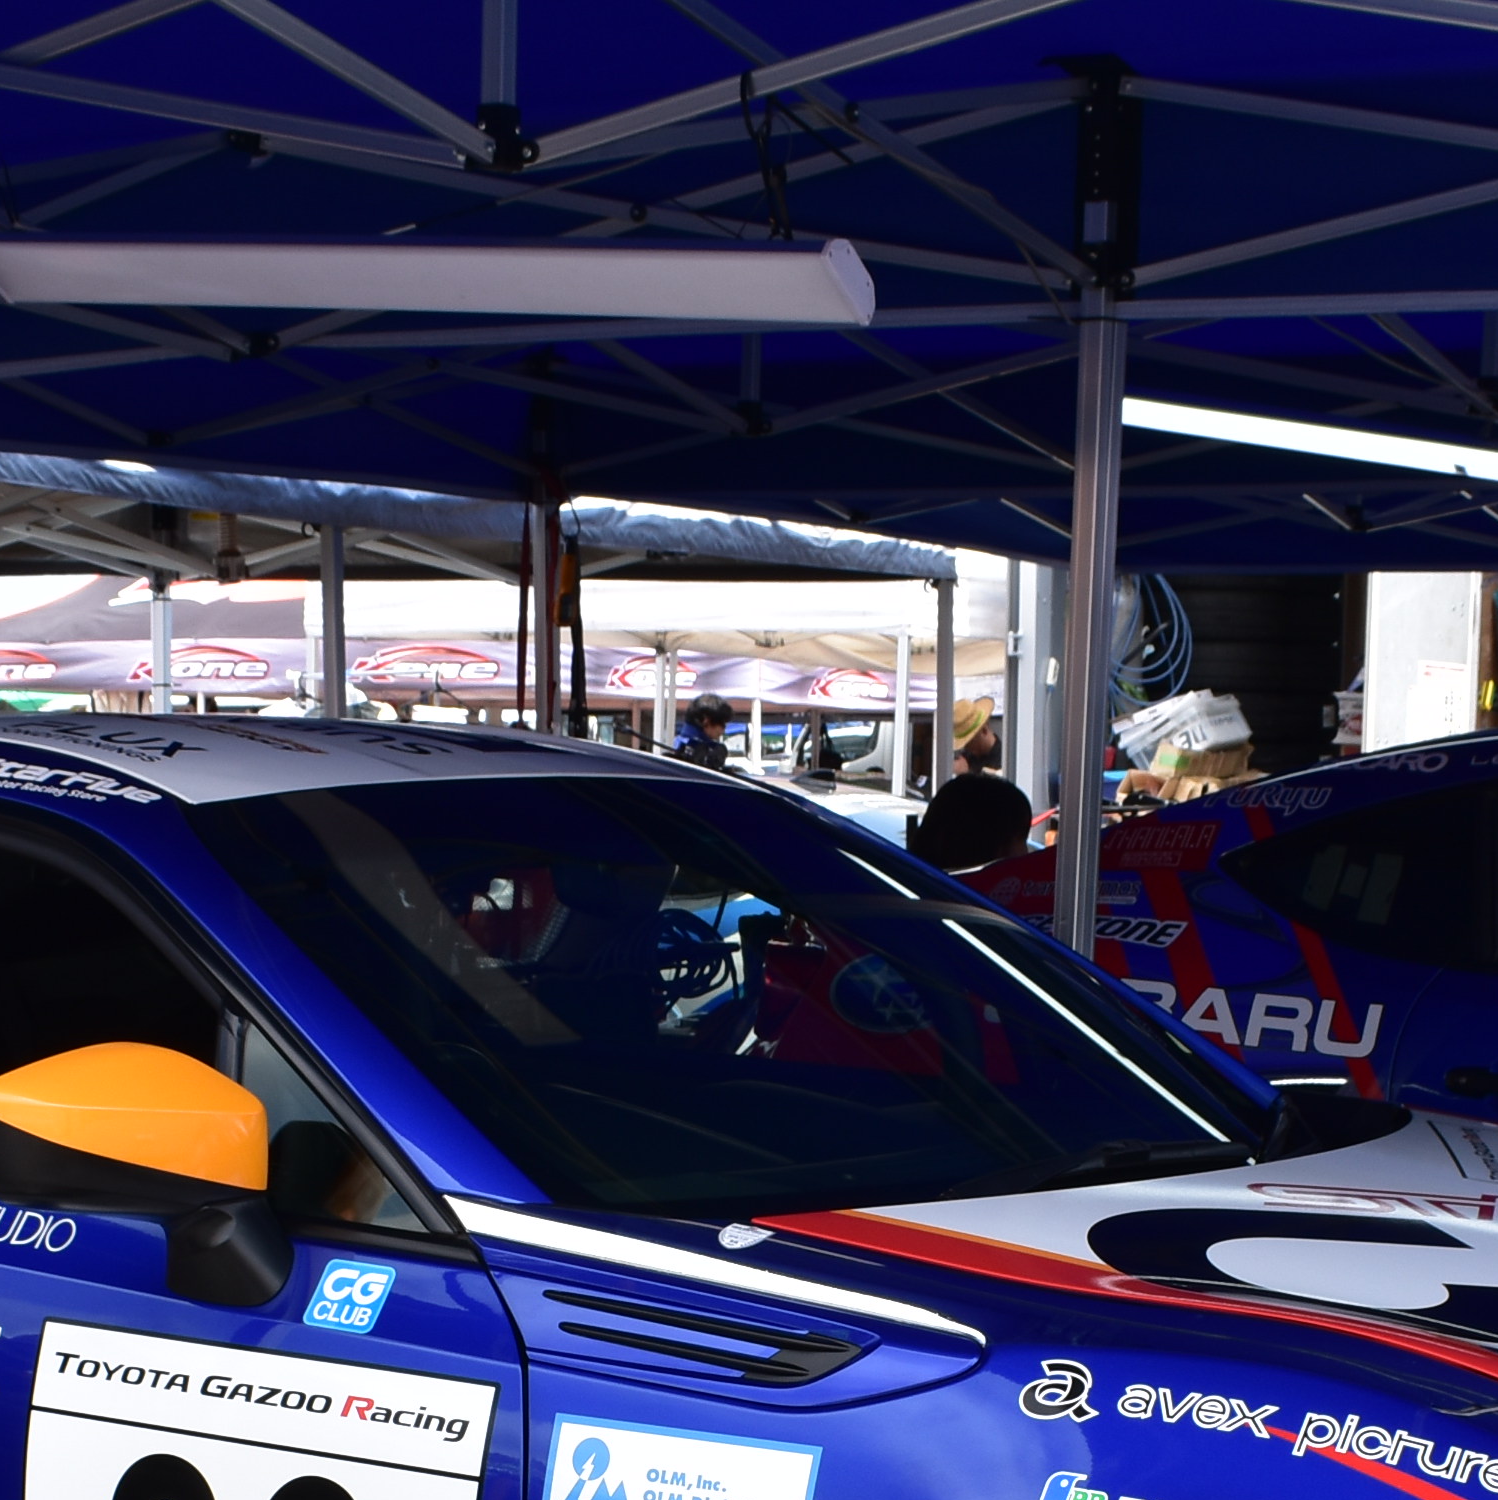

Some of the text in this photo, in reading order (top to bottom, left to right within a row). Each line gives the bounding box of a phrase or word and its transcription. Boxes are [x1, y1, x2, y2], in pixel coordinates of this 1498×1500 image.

[319, 1267, 387, 1306] CG
[310, 1299, 374, 1328] CLUB
[55, 1351, 470, 1443] TOYOTA GAZOO Racing
[1117, 1381, 1271, 1439] avex
[646, 1468, 728, 1493] OLM, Inc.
